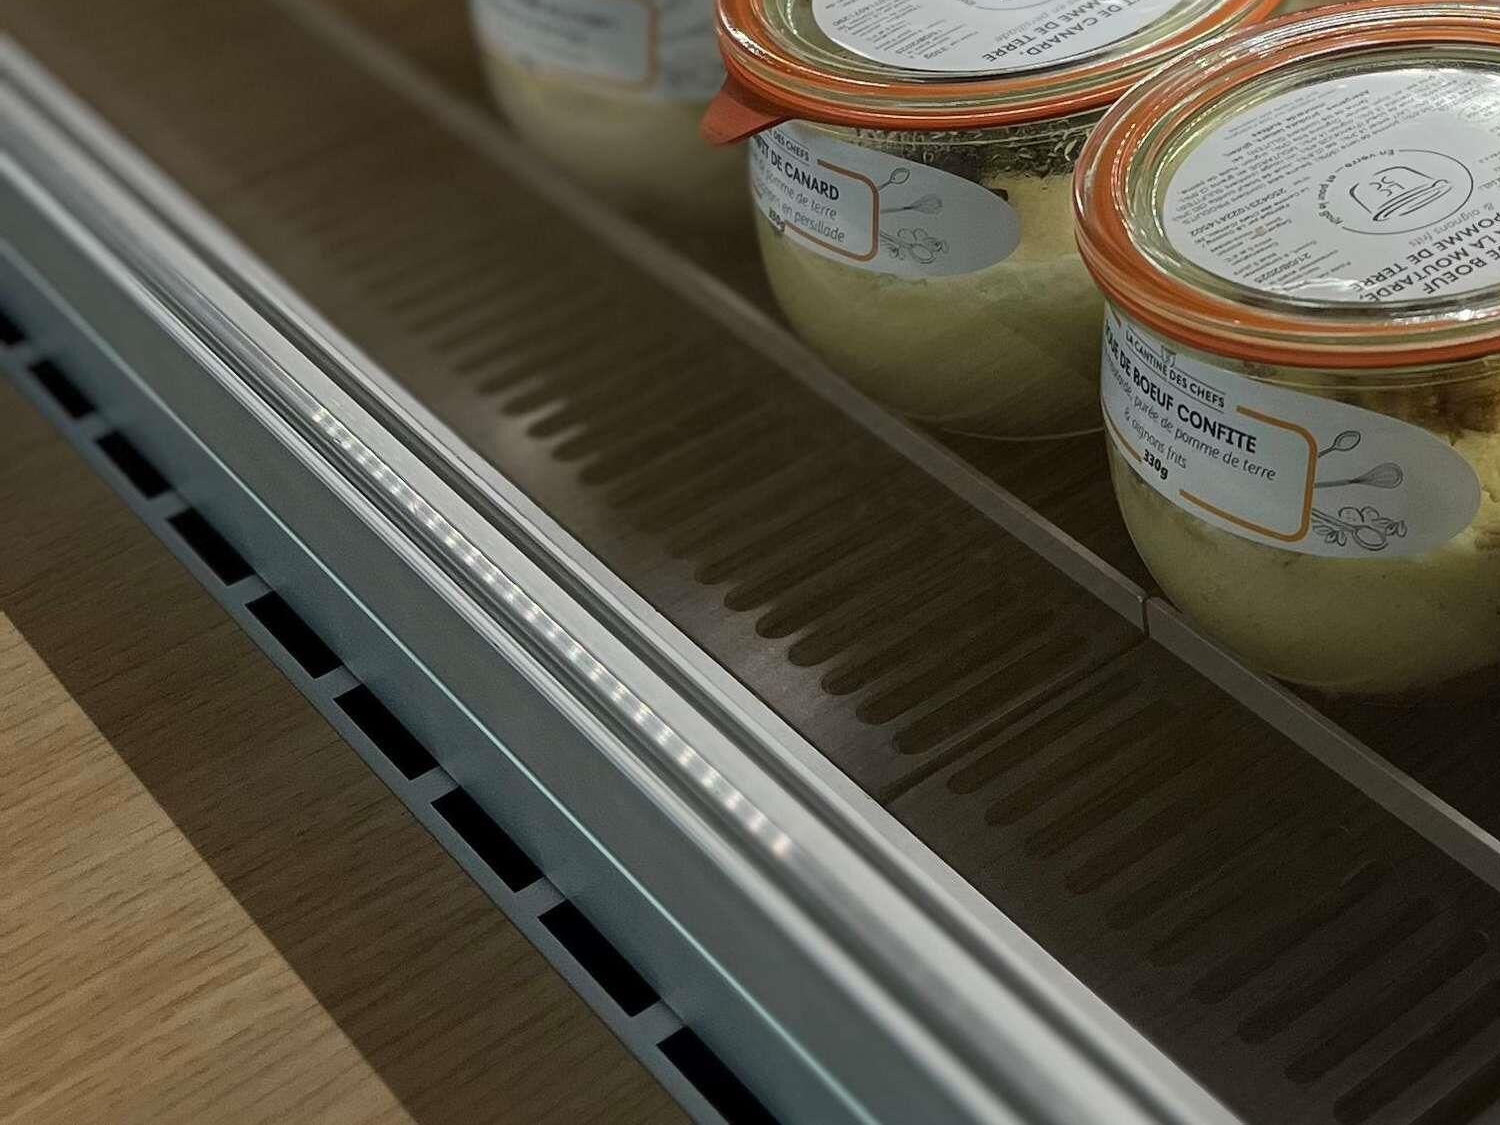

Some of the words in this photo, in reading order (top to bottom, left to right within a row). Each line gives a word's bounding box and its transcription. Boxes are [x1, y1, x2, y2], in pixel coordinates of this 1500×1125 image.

[1096, 3, 1123, 18] DE
[1032, 20, 1060, 35] DE
[981, 34, 1036, 62] TERRE
[770, 150, 783, 172] DE
[784, 161, 840, 201] CANARD
[793, 211, 846, 245] persillade
[1432, 208, 1480, 235] oignons
[1405, 247, 1434, 265] DE
[1468, 234, 1497, 249] LA
[1353, 262, 1408, 292] TERRE
[1422, 256, 1487, 294] BOEUF
[1132, 339, 1168, 377] CANTINE
[1168, 369, 1188, 389] DES
[1188, 382, 1226, 409] CHEFS
[1119, 350, 1132, 378] DE
[1132, 365, 1175, 413] BOEUF
[1176, 403, 1258, 455] CONFITE
[1142, 447, 1170, 481] 330g
[1166, 444, 1188, 470] frits
[1173, 427, 1221, 460] pomme
[1221, 450, 1241, 469] de
[1241, 455, 1278, 482] terre
